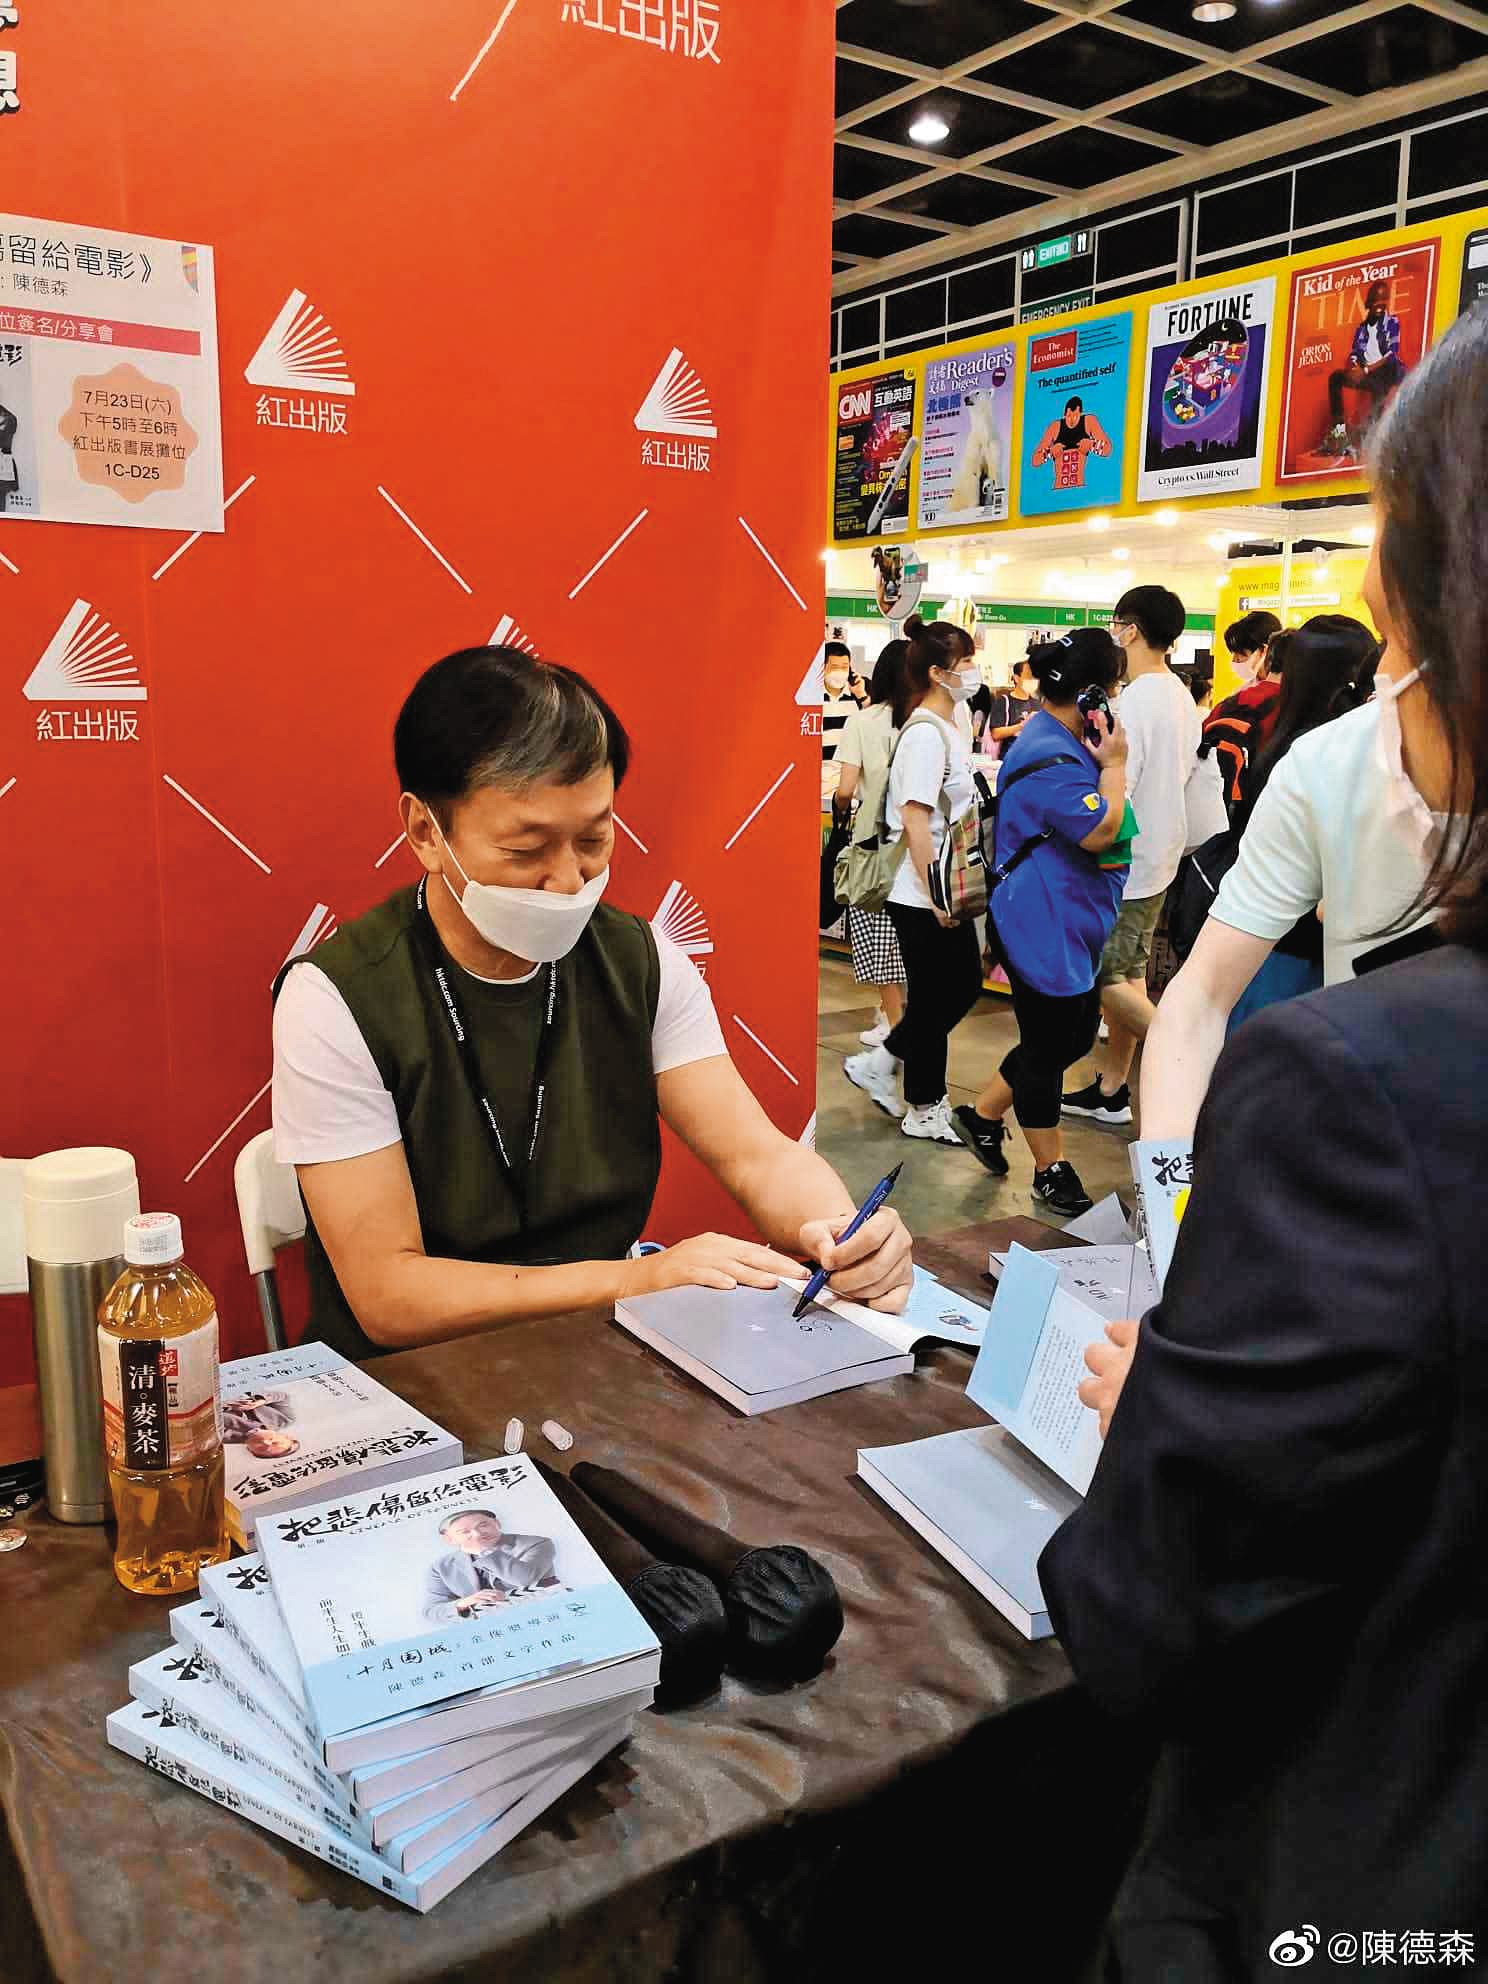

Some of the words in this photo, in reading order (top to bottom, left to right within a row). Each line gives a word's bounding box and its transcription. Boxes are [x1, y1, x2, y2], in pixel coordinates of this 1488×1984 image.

[0, 233, 152, 283] 留給電影》
[1303, 274, 1333, 296] Kid
[1335, 277, 1345, 290] of
[1346, 275, 1361, 287] the
[1361, 264, 1398, 283] Year
[1021, 303, 1070, 323] EMERGENCY
[1072, 297, 1091, 311] EXIT
[1168, 293, 1253, 337] FORTUNE
[0, 344, 23, 367] 影
[1033, 347, 1074, 364] Economist
[1048, 341, 1060, 350] The
[1302, 343, 1331, 356] ORION
[947, 347, 1013, 379] Reader's
[1038, 376, 1053, 388] The
[1054, 369, 1098, 387] quantified
[1099, 362, 1116, 375] self
[874, 385, 913, 408] 互動英語
[951, 377, 978, 392] Digest
[83, 390, 172, 416] 7月23日(六)
[255, 393, 349, 435] 紅出版
[839, 390, 872, 420] CNN
[80, 411, 177, 437] 下午5時至6時
[72, 434, 186, 459] 紅出版書展攤位
[641, 437, 711, 472] 紅出版
[105, 463, 160, 480] 1C-D25
[1158, 472, 1185, 486] Crypto
[1215, 466, 1240, 479] Street
[36, 708, 140, 741] 紅出版
[800, 711, 823, 736] 紅
